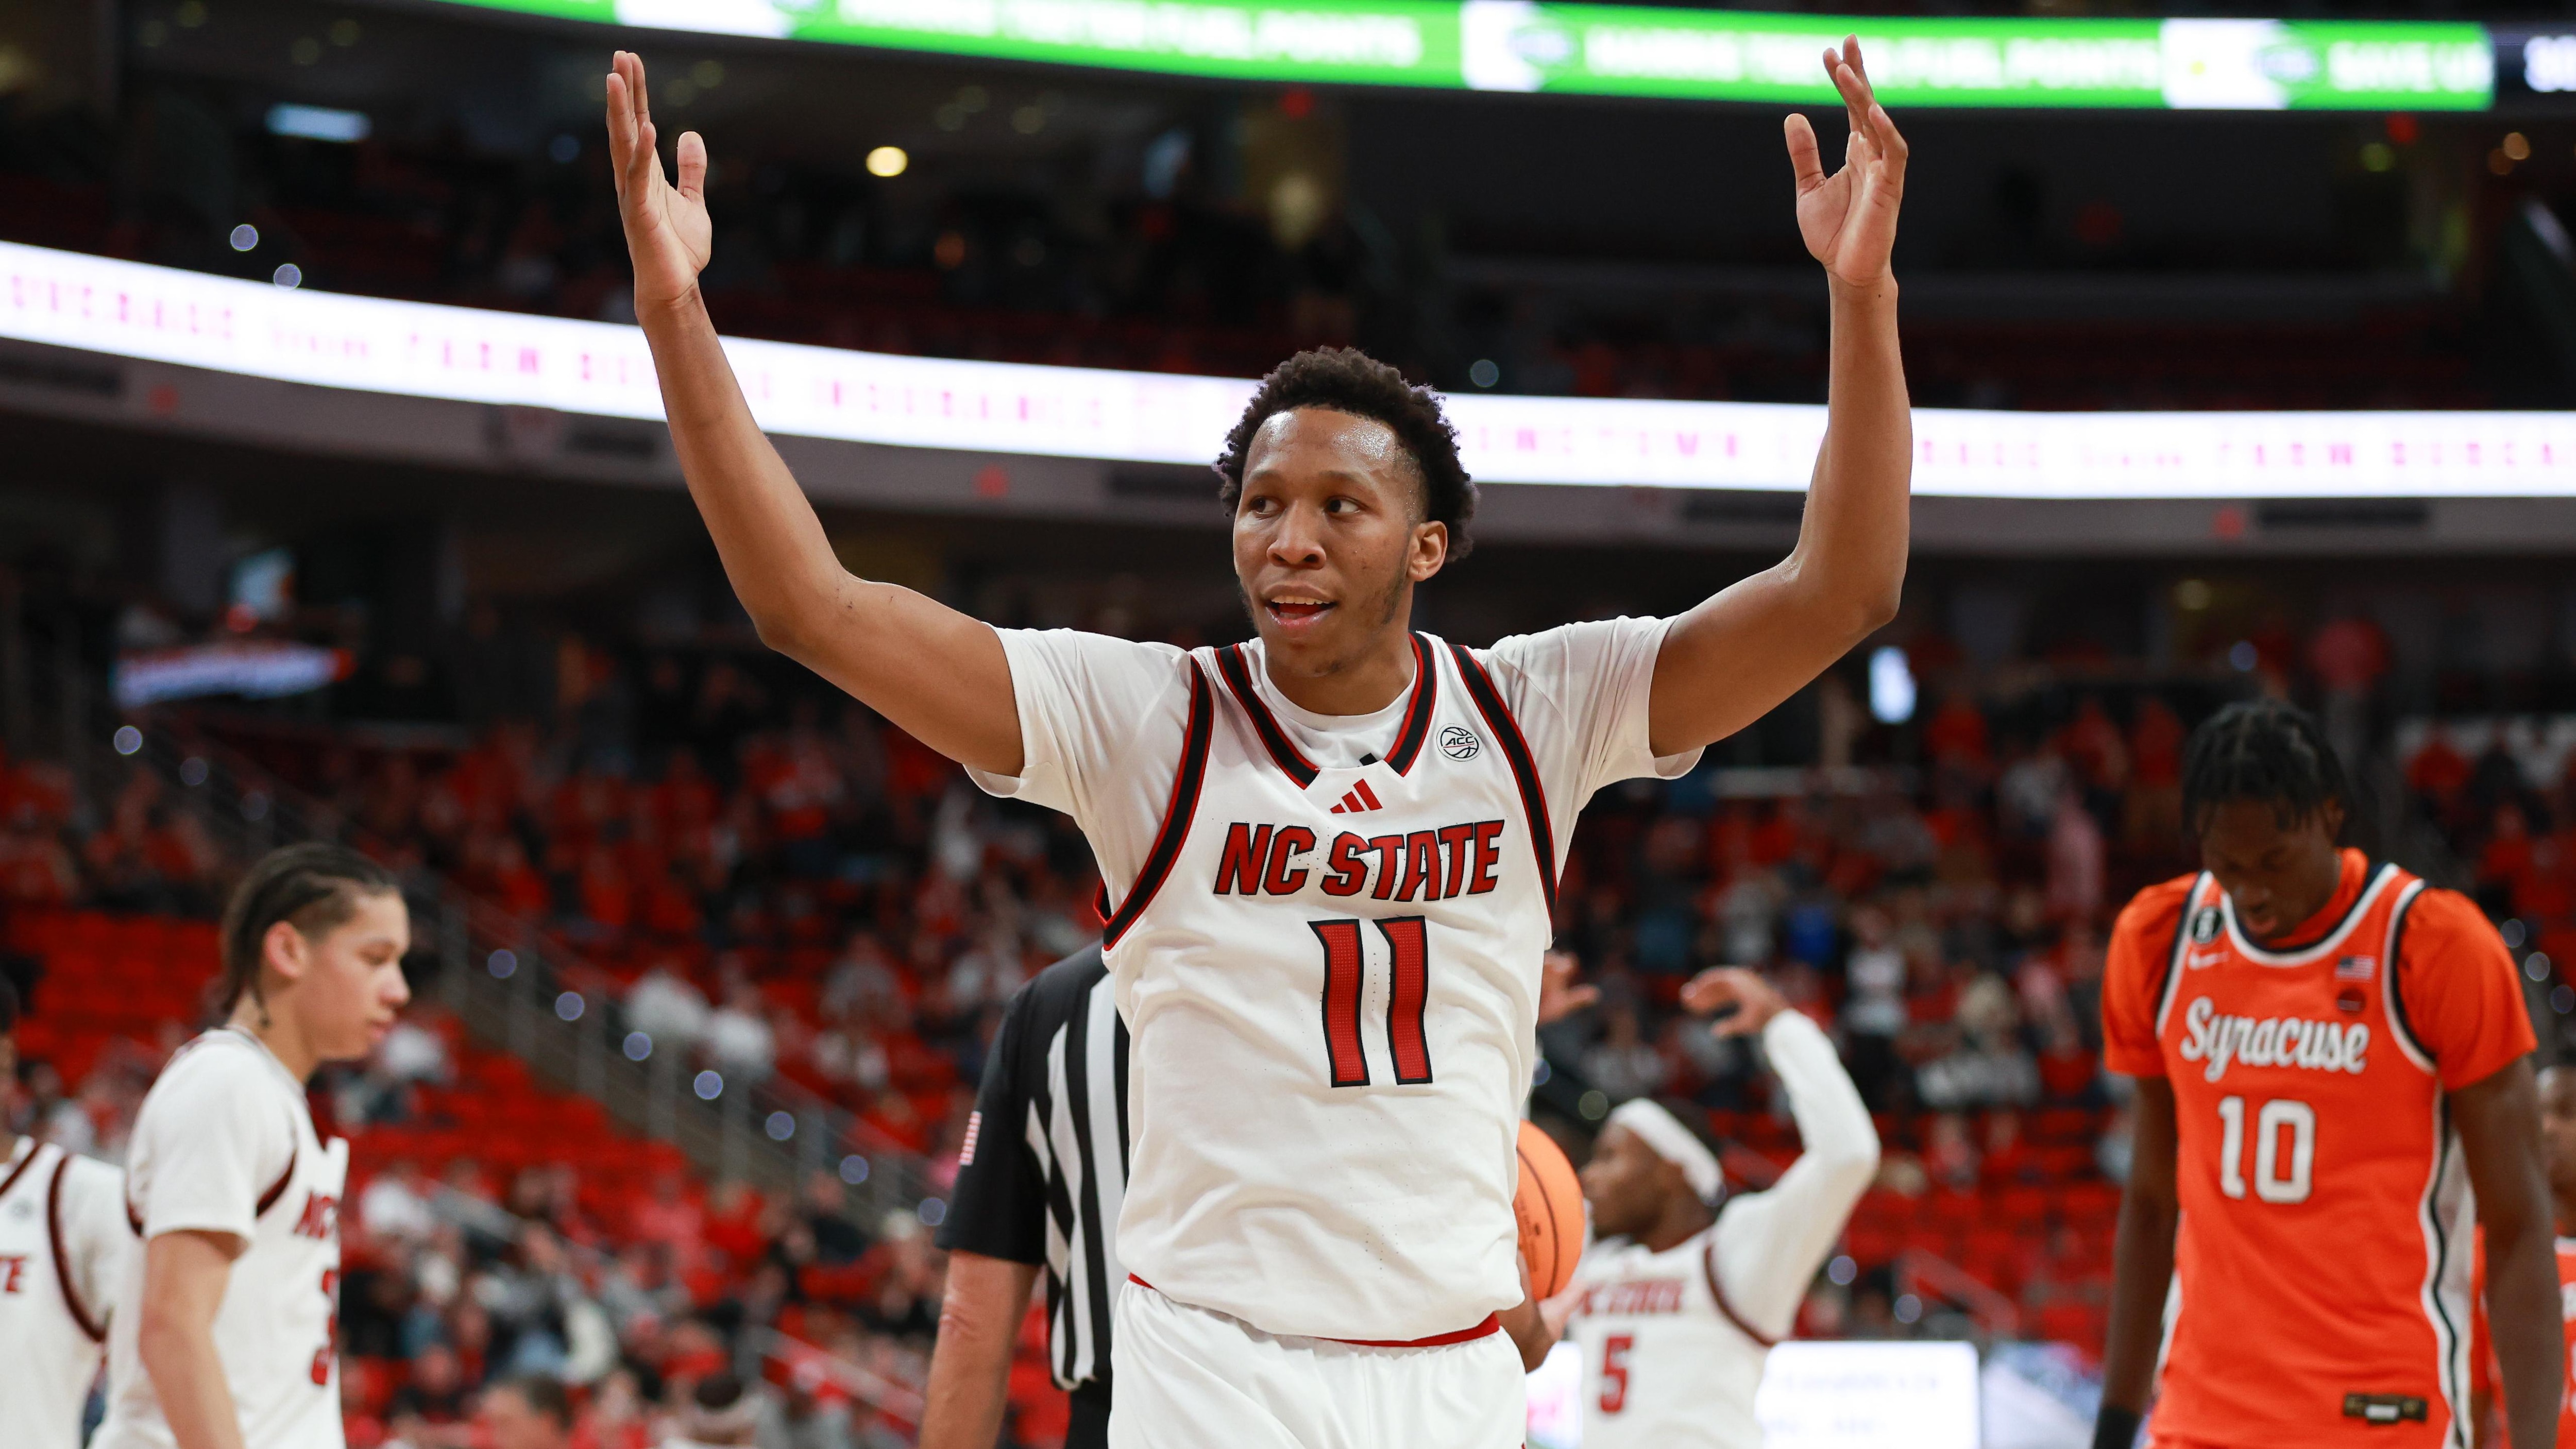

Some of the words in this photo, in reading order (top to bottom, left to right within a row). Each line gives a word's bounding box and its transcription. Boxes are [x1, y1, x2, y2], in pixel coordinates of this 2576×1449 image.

[1445, 736, 1475, 745] ACC
[1214, 822, 1316, 896] NC
[1320, 819, 1504, 902] STATE
[1308, 915, 1433, 1087] 11
[2181, 996, 2370, 1082] Syracuse
[2218, 1095, 2315, 1204] 10
[1600, 1335, 1634, 1413] 5
